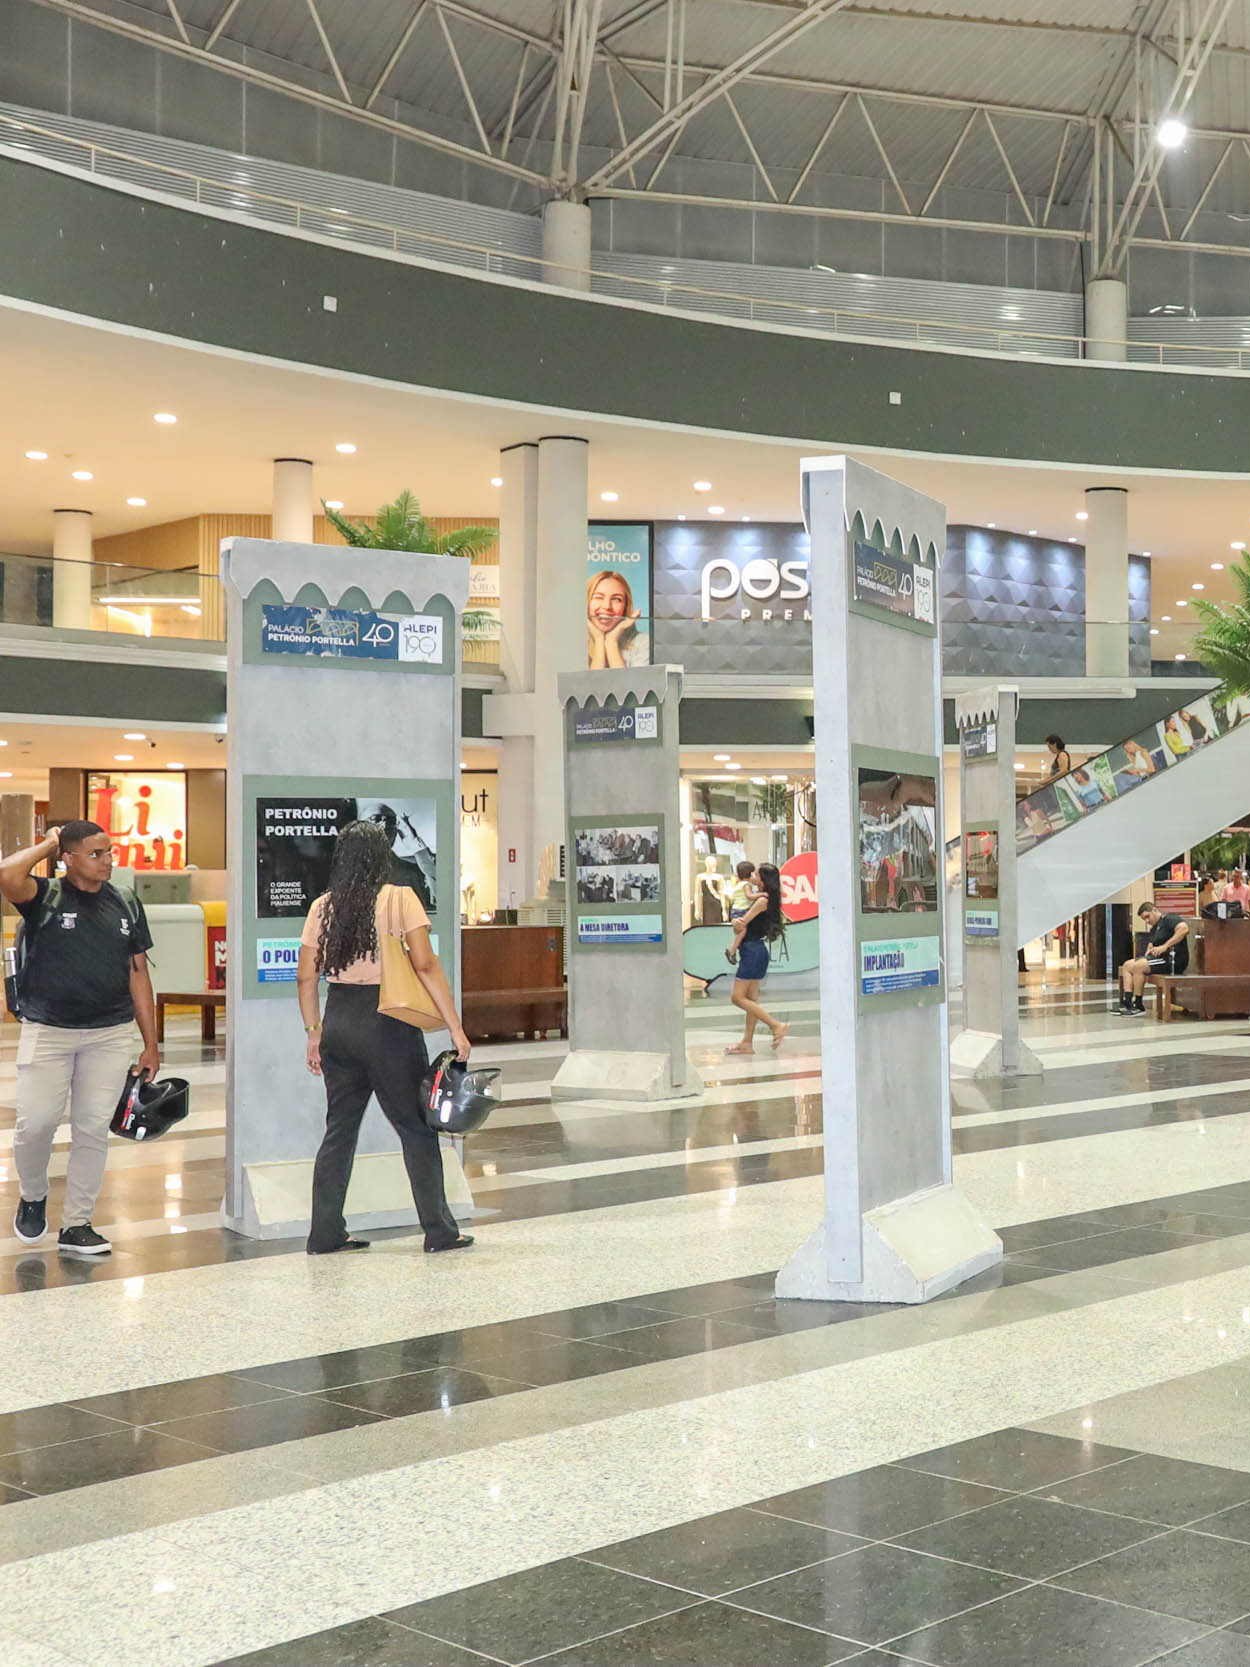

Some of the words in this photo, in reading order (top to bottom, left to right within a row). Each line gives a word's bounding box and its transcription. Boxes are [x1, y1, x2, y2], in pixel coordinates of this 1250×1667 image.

[267, 623, 305, 634] PALÁCIO
[403, 624, 438, 635] ALEPI
[267, 633, 311, 644] PETRÔNIO
[311, 636, 356, 646] PORTELLA
[361, 623, 395, 648] 40
[265, 807, 338, 820] PETRÔNIO
[265, 826, 339, 837] PORTELLA
[780, 874, 818, 905] SA
[263, 950, 271, 963] O
[864, 950, 905, 972] IMPLANTAÇÃO
